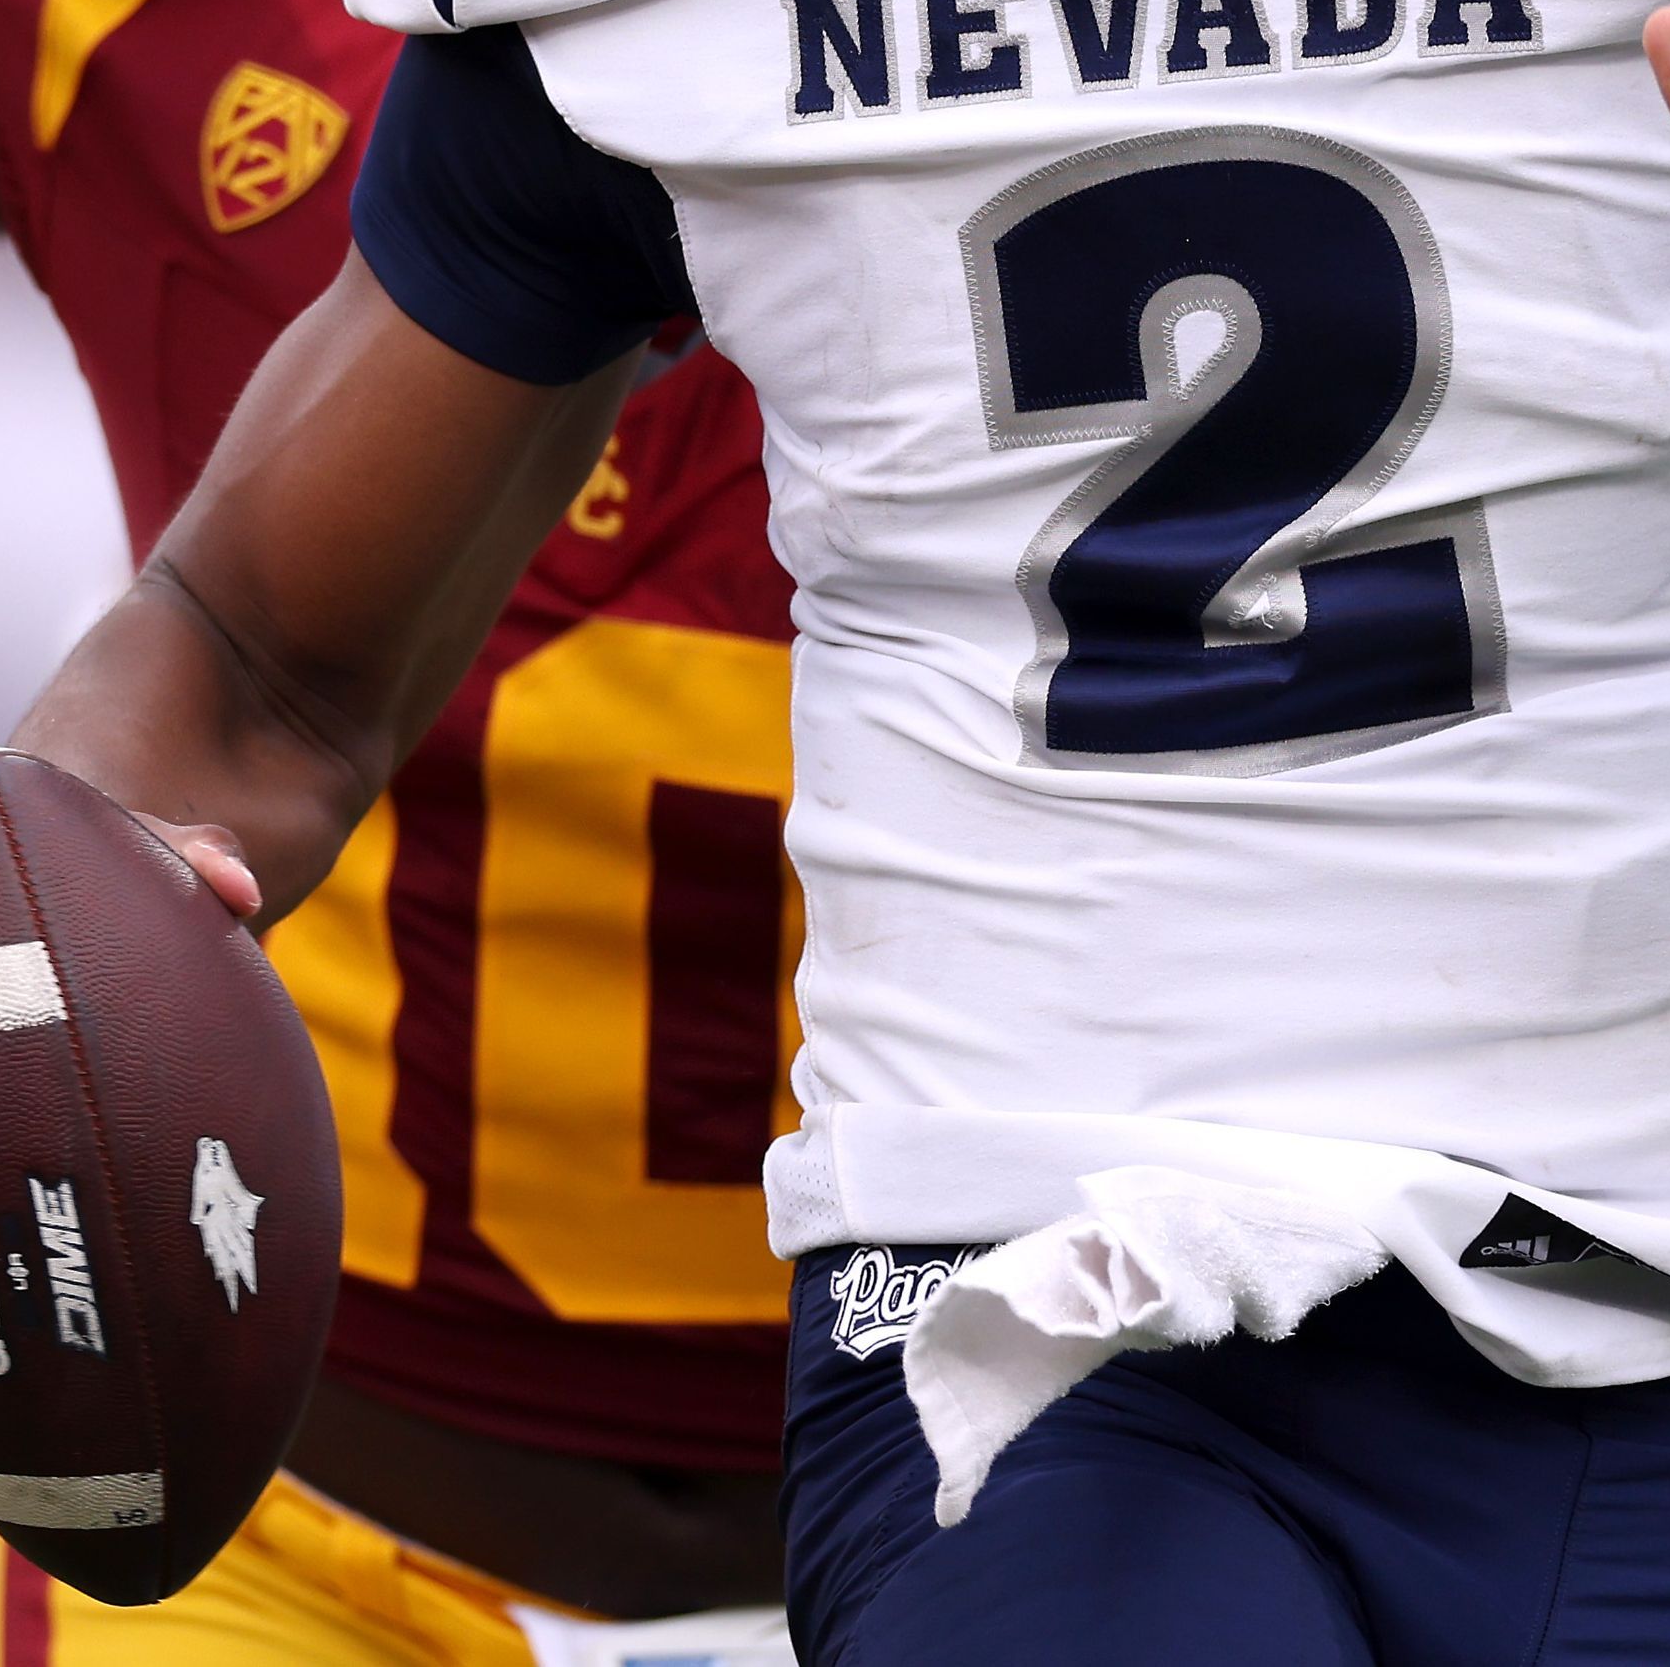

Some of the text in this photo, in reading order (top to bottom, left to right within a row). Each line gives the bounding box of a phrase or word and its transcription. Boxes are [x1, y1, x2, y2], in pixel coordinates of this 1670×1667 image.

[960, 124, 1512, 779] 2
[27, 1177, 108, 1356] DIME
[830, 1243, 989, 1345] Pac
